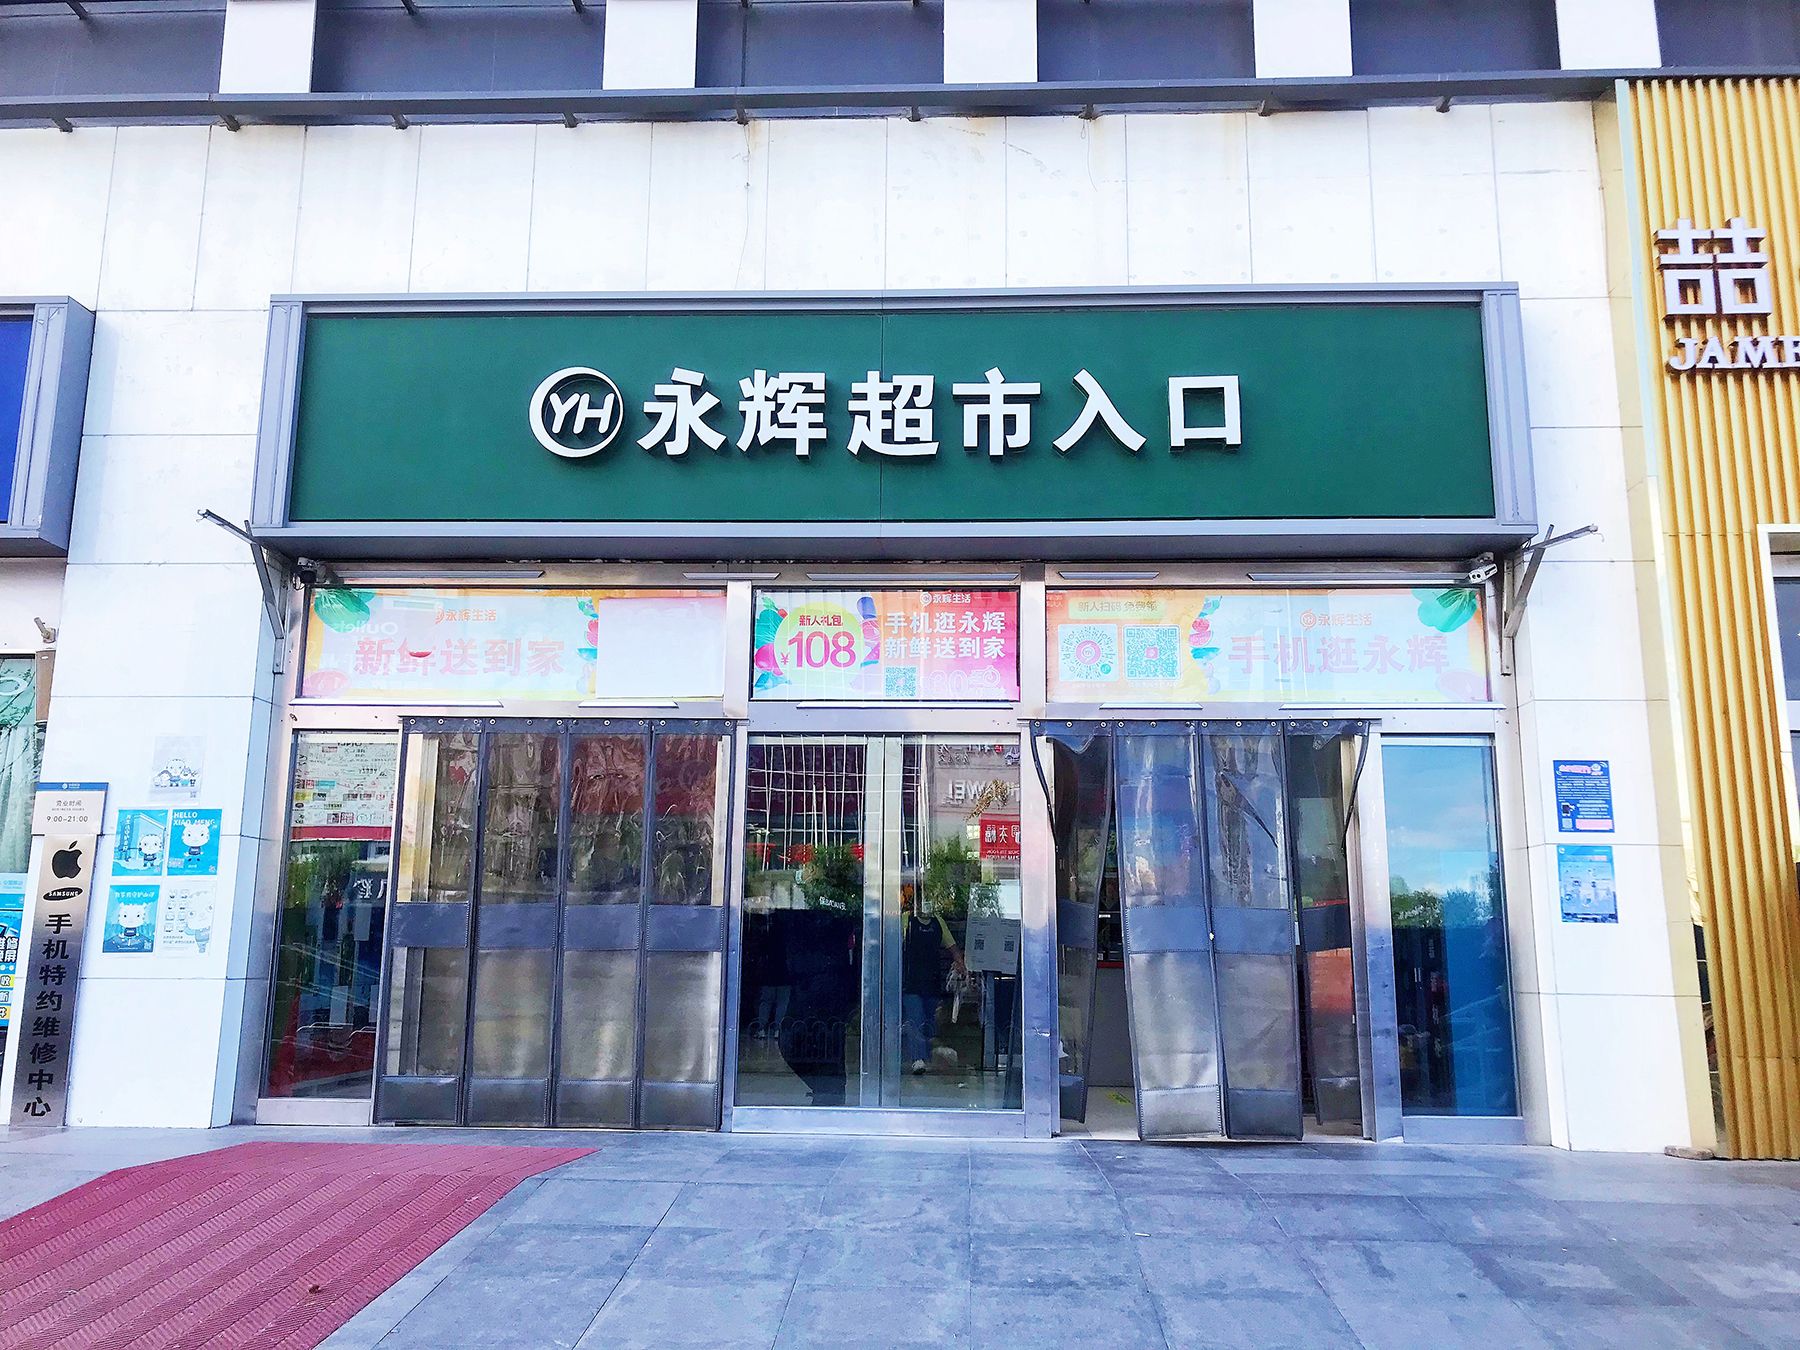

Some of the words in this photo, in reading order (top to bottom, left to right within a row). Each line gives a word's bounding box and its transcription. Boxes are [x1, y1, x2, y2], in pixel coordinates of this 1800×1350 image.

[635, 366, 1243, 457] 永辉超市入口
[932, 592, 971, 604] 永辉生活
[445, 608, 497, 623] 永辉生活
[798, 614, 844, 627] 新人礼包
[884, 611, 1006, 635] 手机逛永辉
[1317, 612, 1372, 627] 永辉生活
[884, 636, 1006, 660] 新鲜送到家
[1228, 634, 1450, 675] 手机逛永辉
[173, 811, 198, 819] HELLO
[23, 913, 73, 1117] 手机特约维修中心
